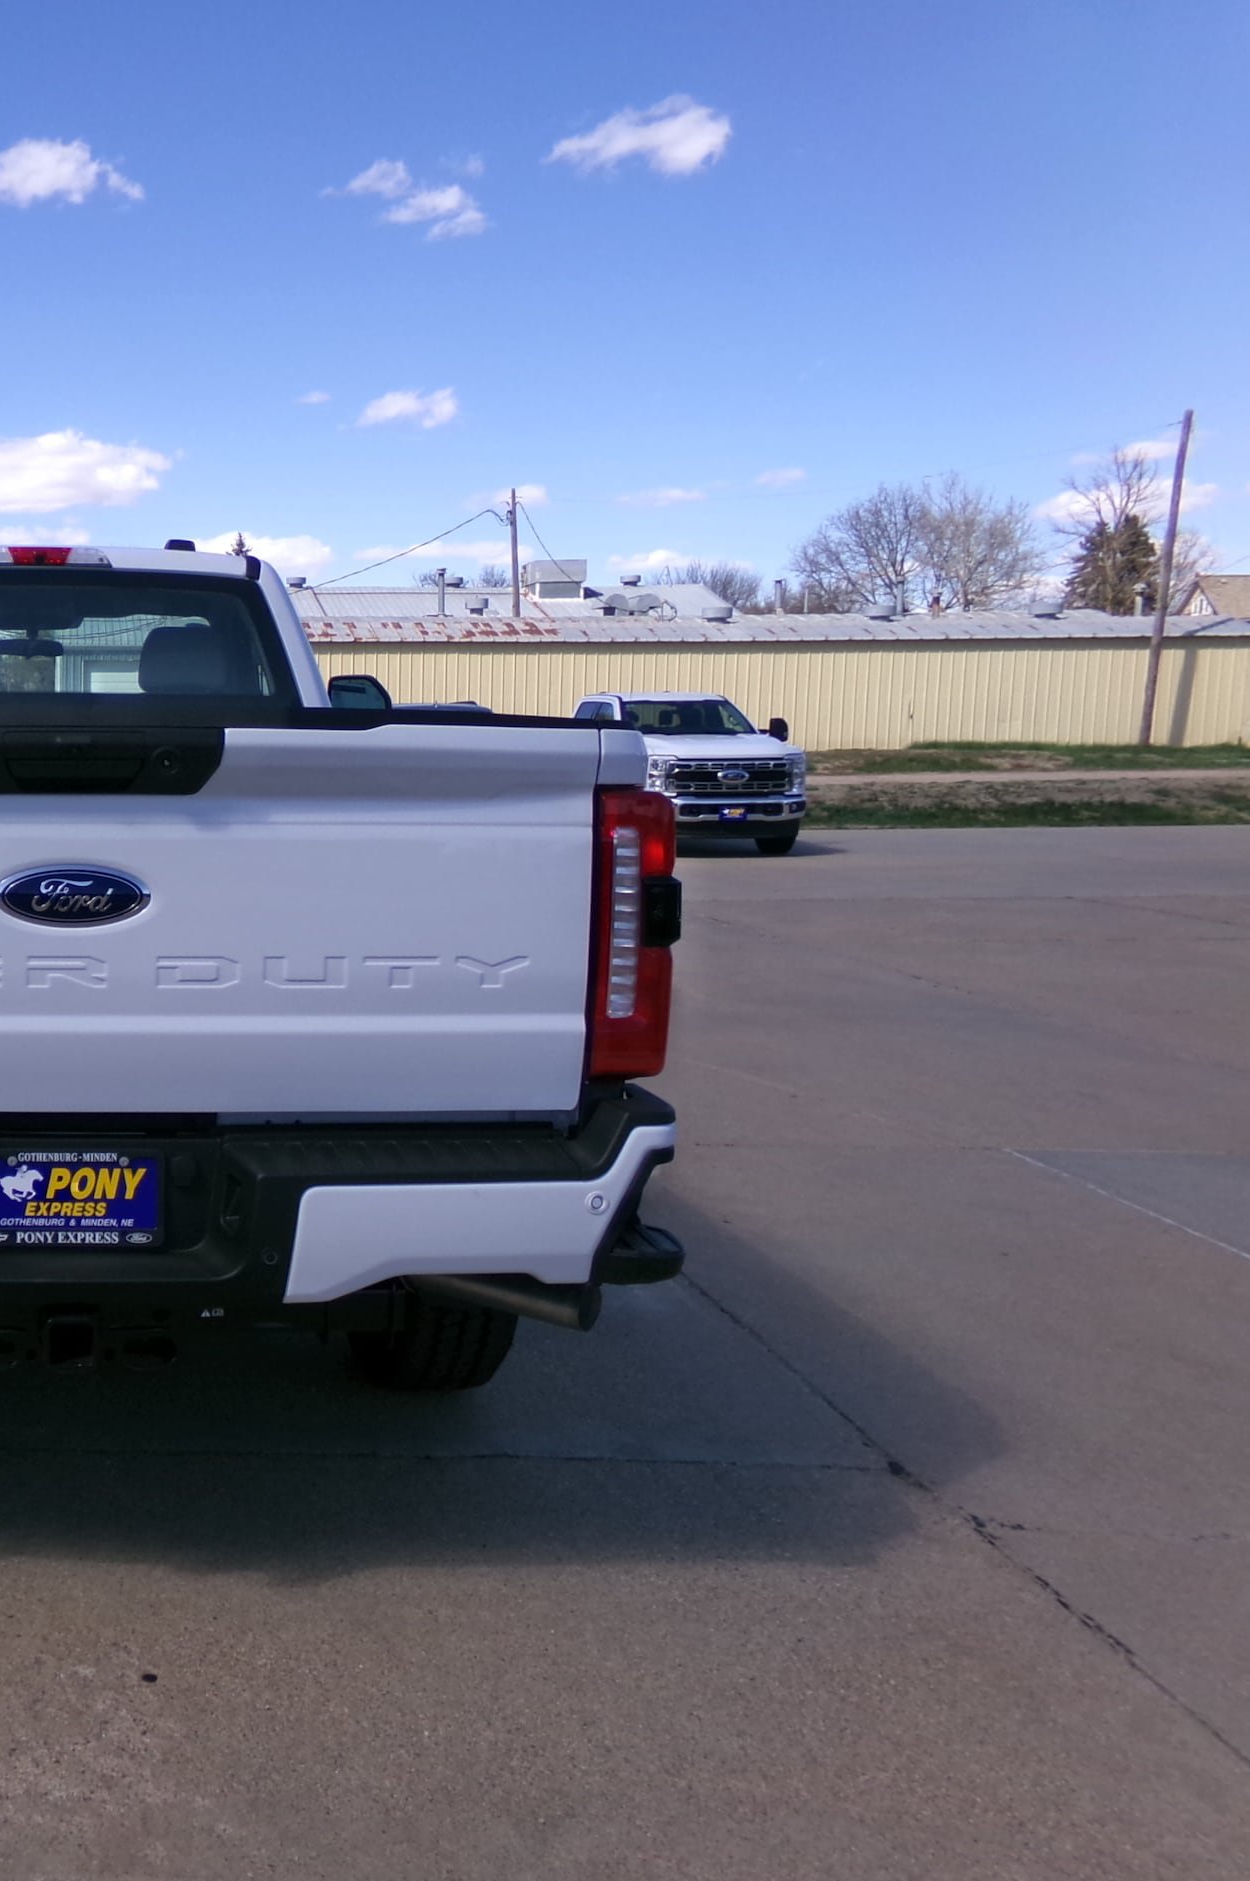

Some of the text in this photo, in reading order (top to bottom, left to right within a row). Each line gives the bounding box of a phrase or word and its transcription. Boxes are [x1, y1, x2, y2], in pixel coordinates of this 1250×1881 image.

[31, 878, 114, 912] Ford
[155, 955, 530, 989] DUTY
[45, 1167, 147, 1200] PONY
[24, 1202, 108, 1217] EXPRESS
[0, 1218, 134, 1228] GOTHENBURG & MINDEN, NE
[15, 1231, 55, 1244] PONY
[58, 1231, 119, 1244] EXPRESS
